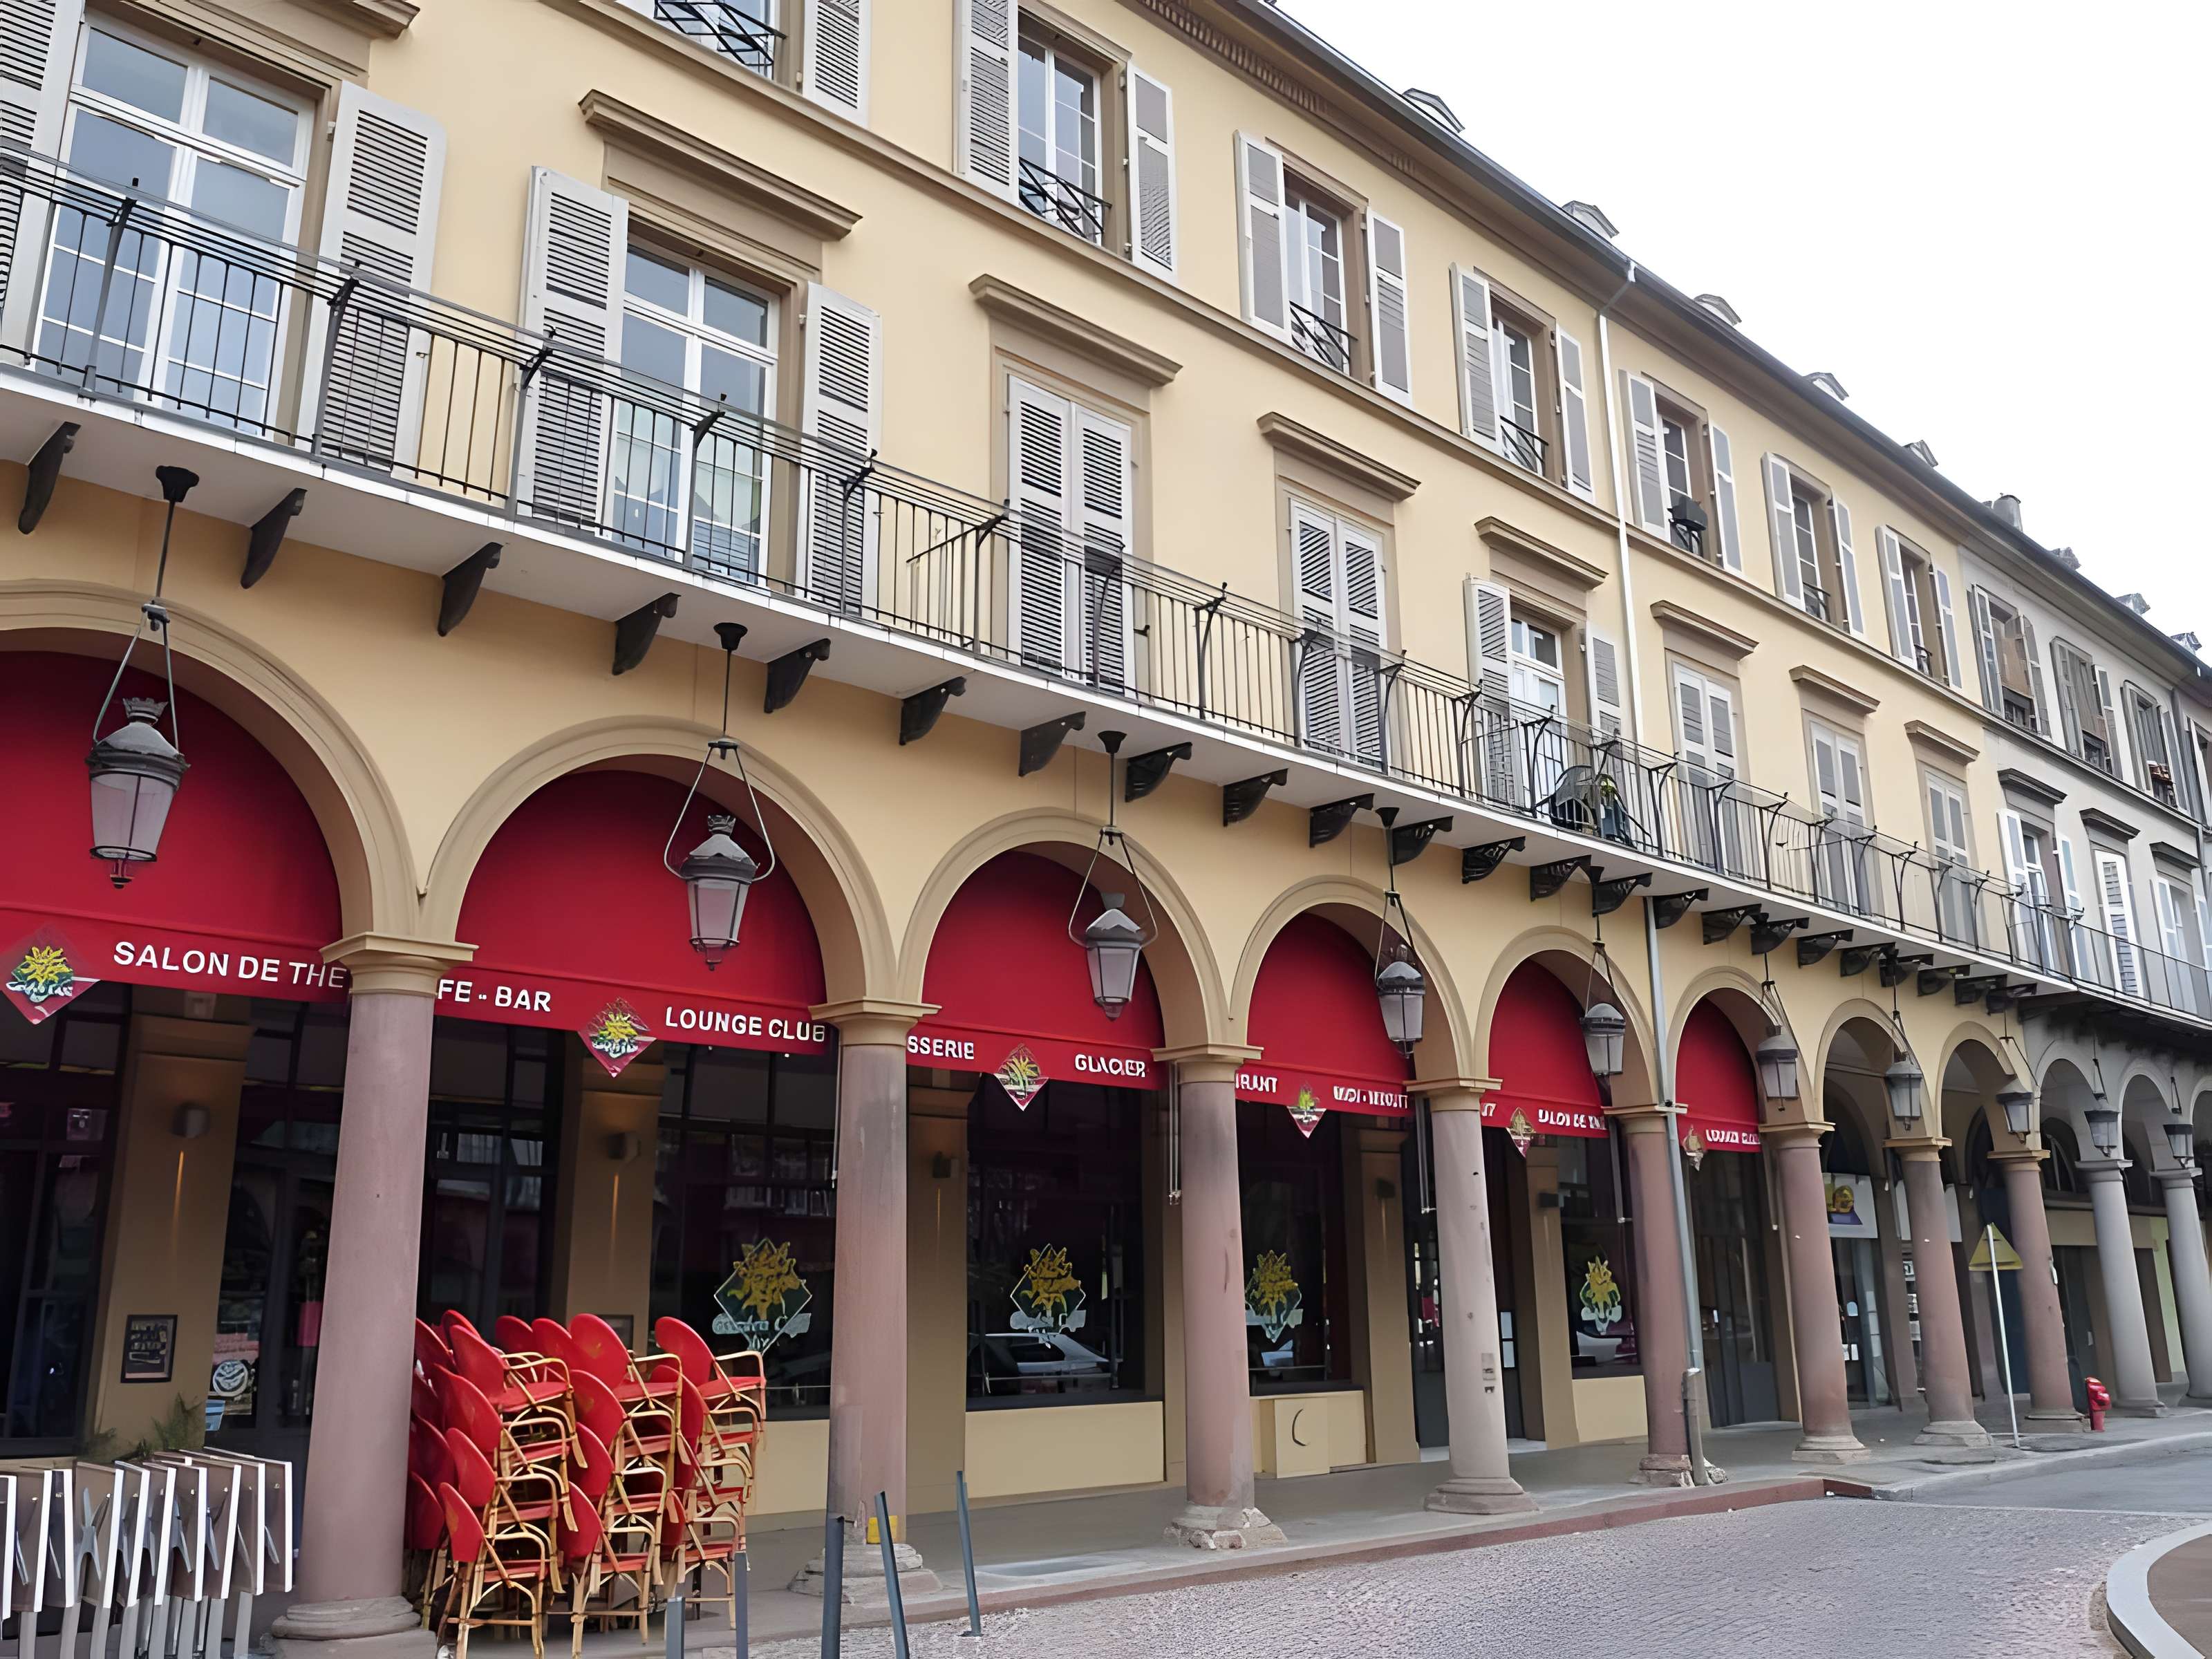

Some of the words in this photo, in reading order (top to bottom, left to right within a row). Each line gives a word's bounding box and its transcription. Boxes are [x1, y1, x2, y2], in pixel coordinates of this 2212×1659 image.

[113, 941, 229, 977] SALON
[238, 956, 280, 982] DE
[288, 962, 347, 988] THE
[495, 986, 552, 1012] BAR
[666, 1006, 762, 1036] LOUNGE
[768, 1018, 825, 1042] CLUB
[906, 1035, 975, 1060] SSERIE
